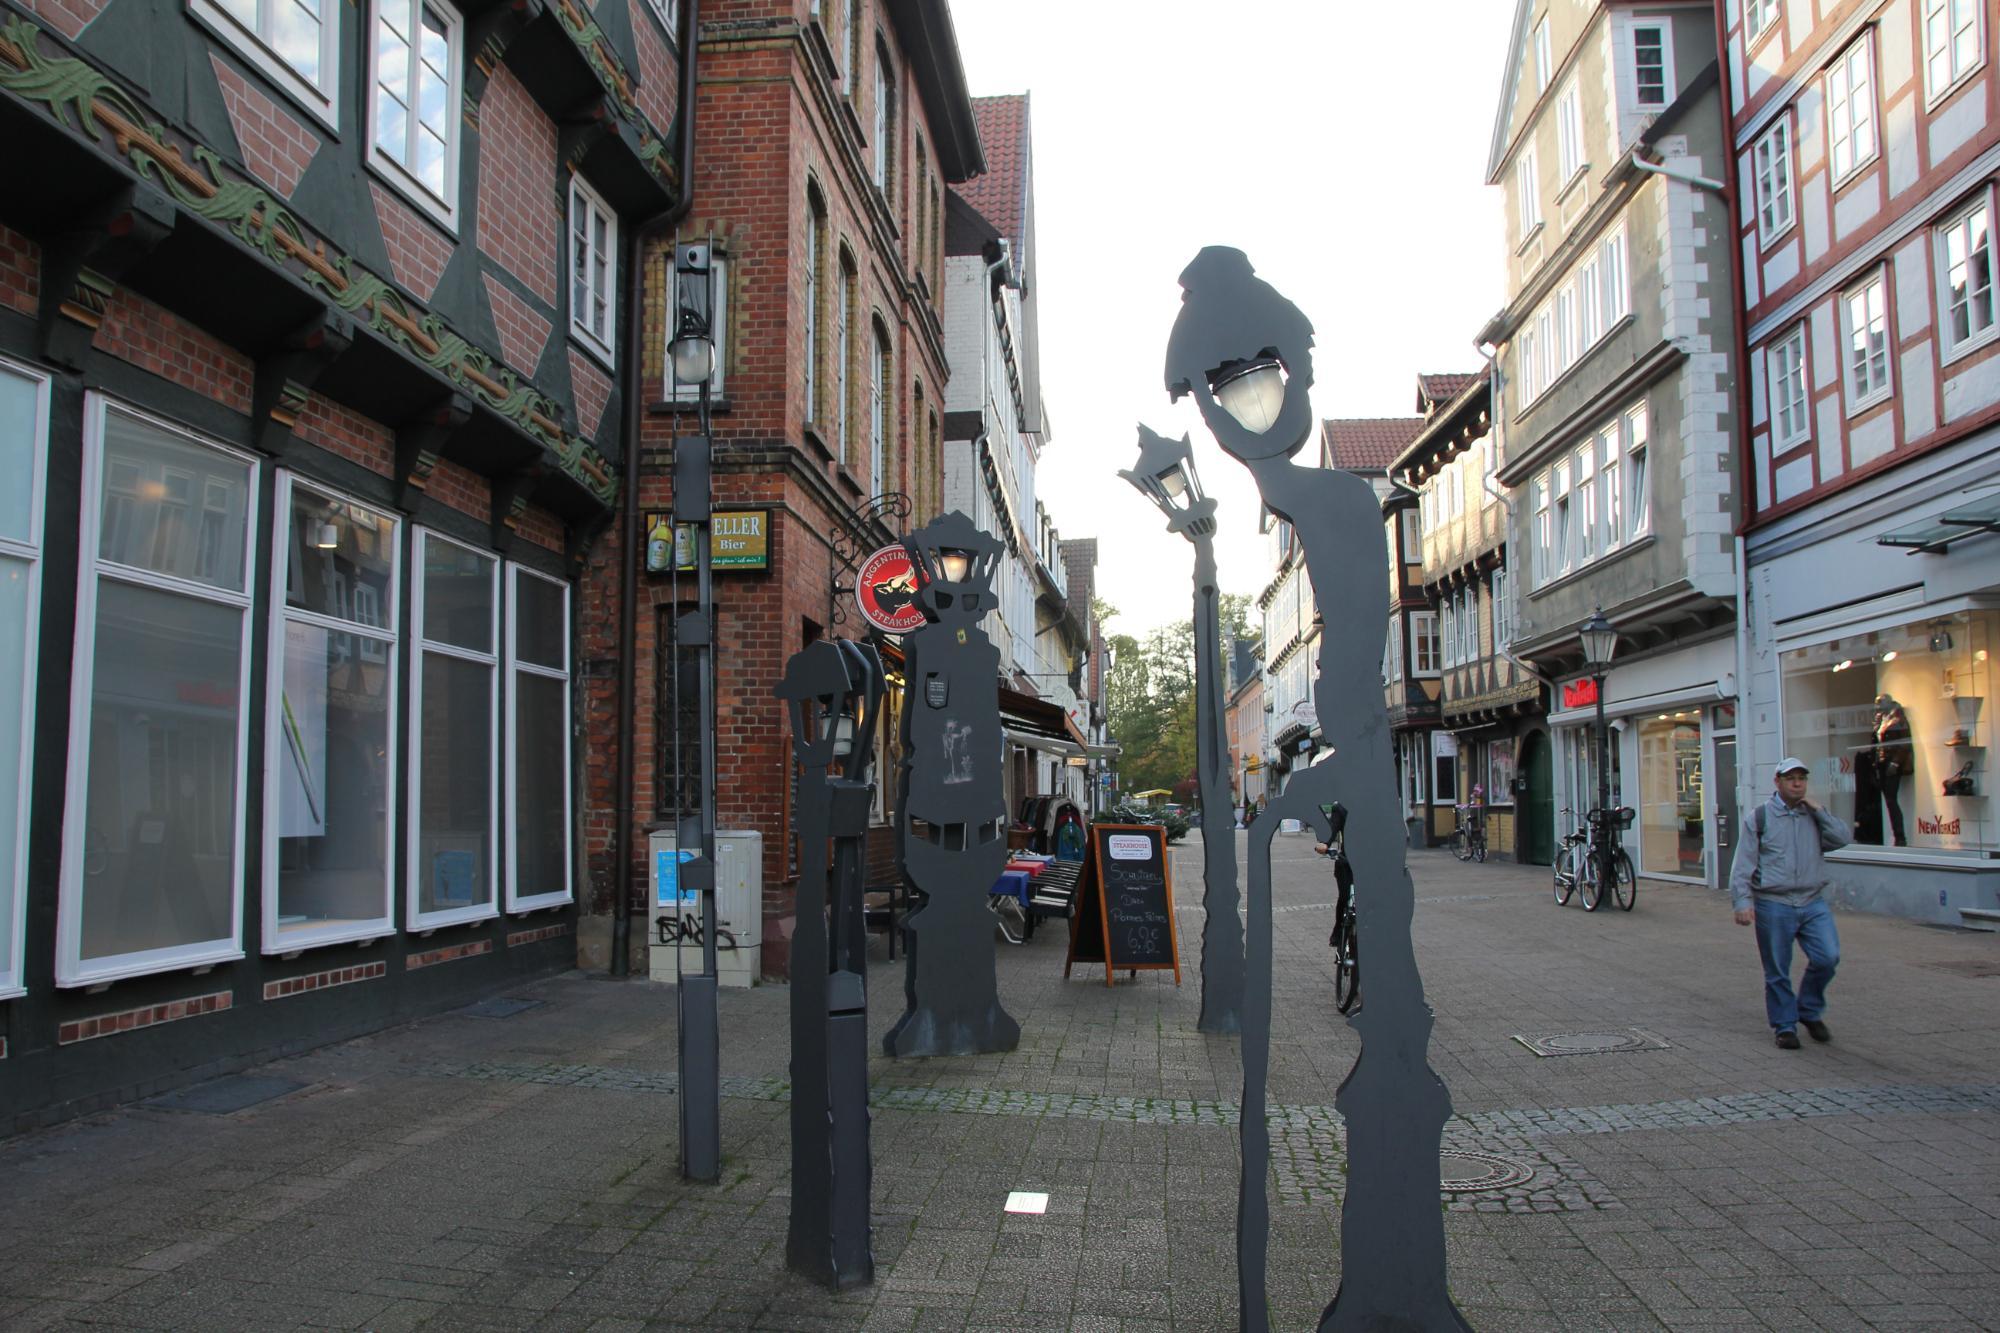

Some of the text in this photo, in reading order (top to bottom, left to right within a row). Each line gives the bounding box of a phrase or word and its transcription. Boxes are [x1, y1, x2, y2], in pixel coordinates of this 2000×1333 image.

[711, 516, 760, 536] ELLER
[720, 539, 746, 550] Bier
[872, 609, 924, 627] STEAKHOU
